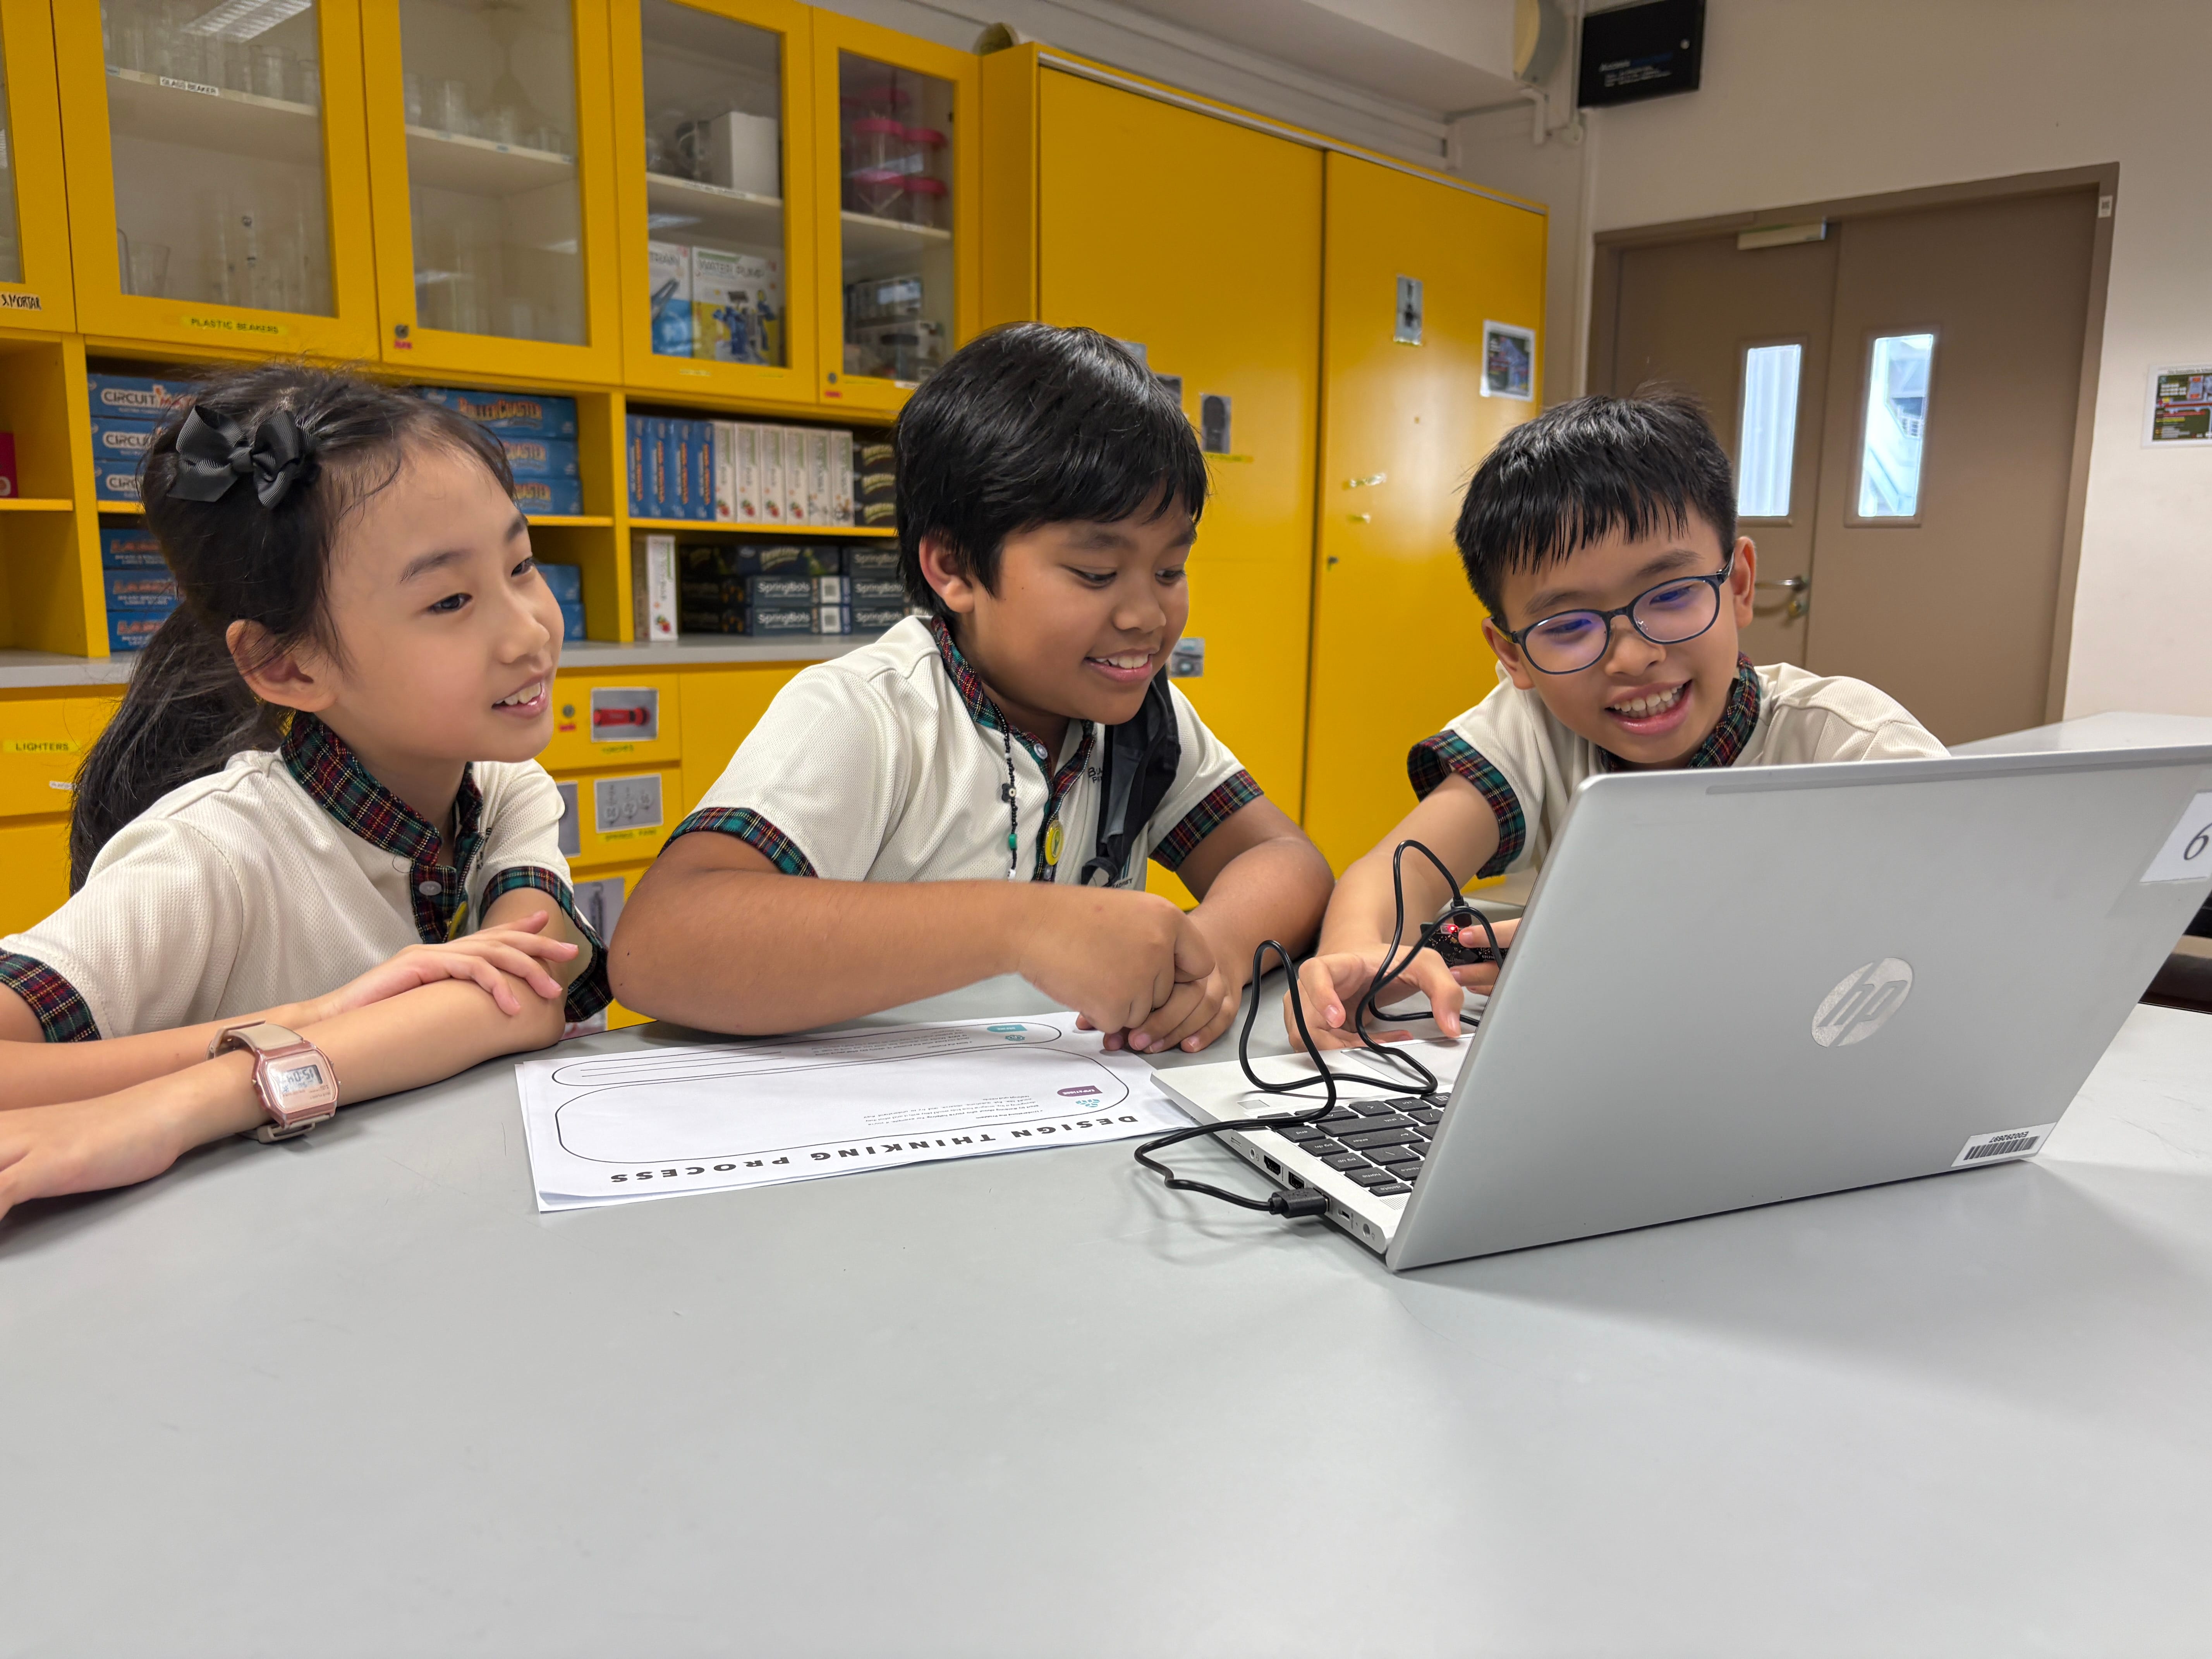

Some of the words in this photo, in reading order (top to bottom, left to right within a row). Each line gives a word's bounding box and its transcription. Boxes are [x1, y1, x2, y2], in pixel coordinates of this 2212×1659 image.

[191, 318, 232, 330] PLASTIC
[236, 322, 279, 334] BEAKERS
[103, 391, 155, 405] CIRCUIT
[15, 742, 69, 752] LIGHTERS
[2183, 823, 2212, 860] 6
[1012, 1115, 1139, 1138] DESIGN
[811, 1133, 997, 1161] THINKING
[611, 1156, 790, 1183] PROCESS
